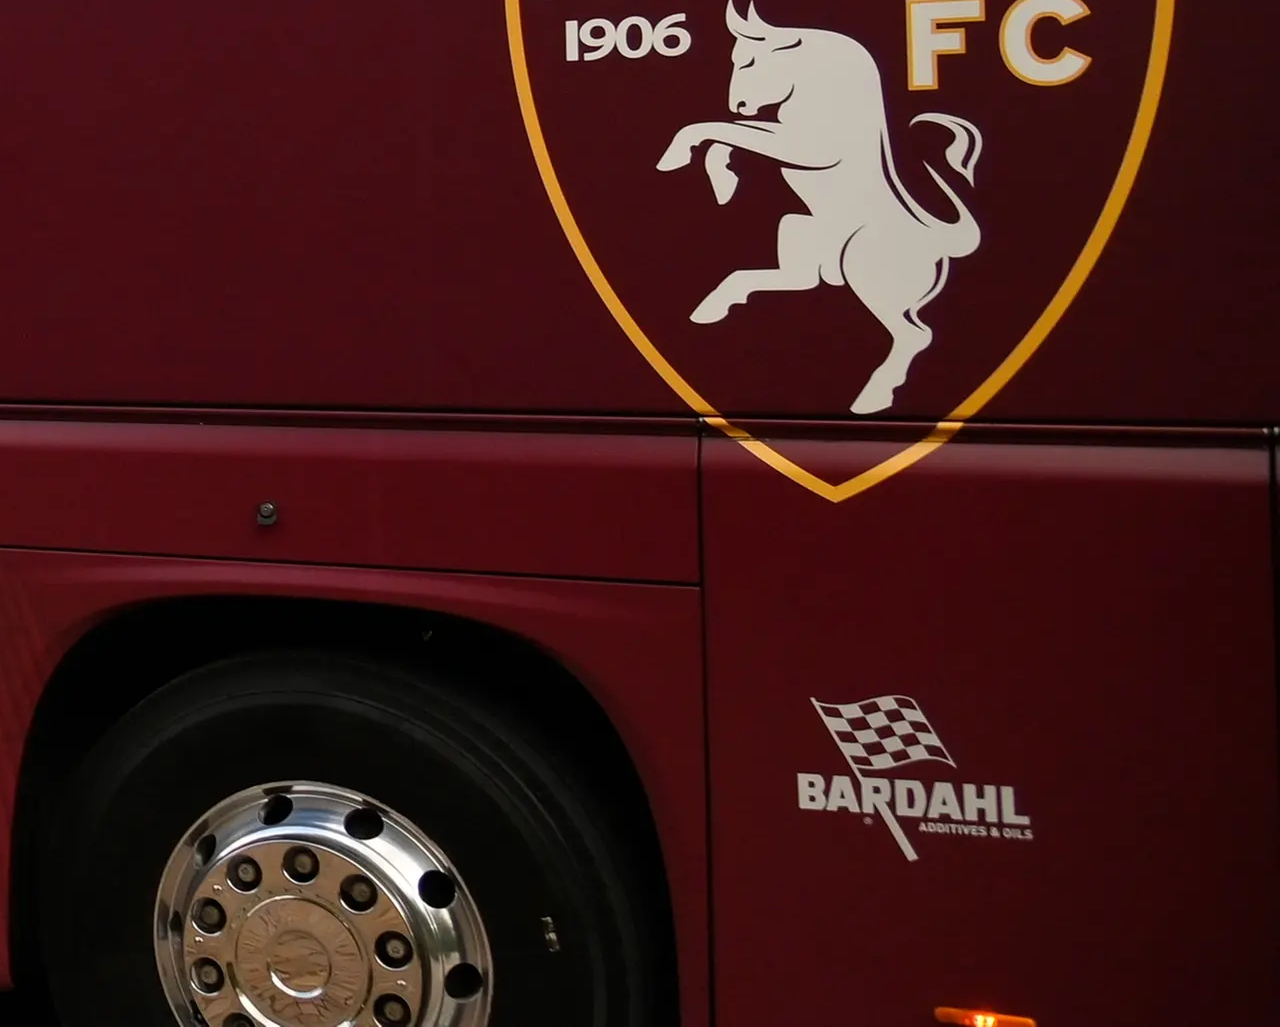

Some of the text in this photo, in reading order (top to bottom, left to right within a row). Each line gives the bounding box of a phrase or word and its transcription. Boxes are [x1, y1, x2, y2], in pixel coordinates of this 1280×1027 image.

[565, 13, 692, 62] 1906
[797, 772, 1030, 825] BARDAHL
[919, 821, 988, 838] ADDITIVES
[1003, 828, 1033, 840] OILS
